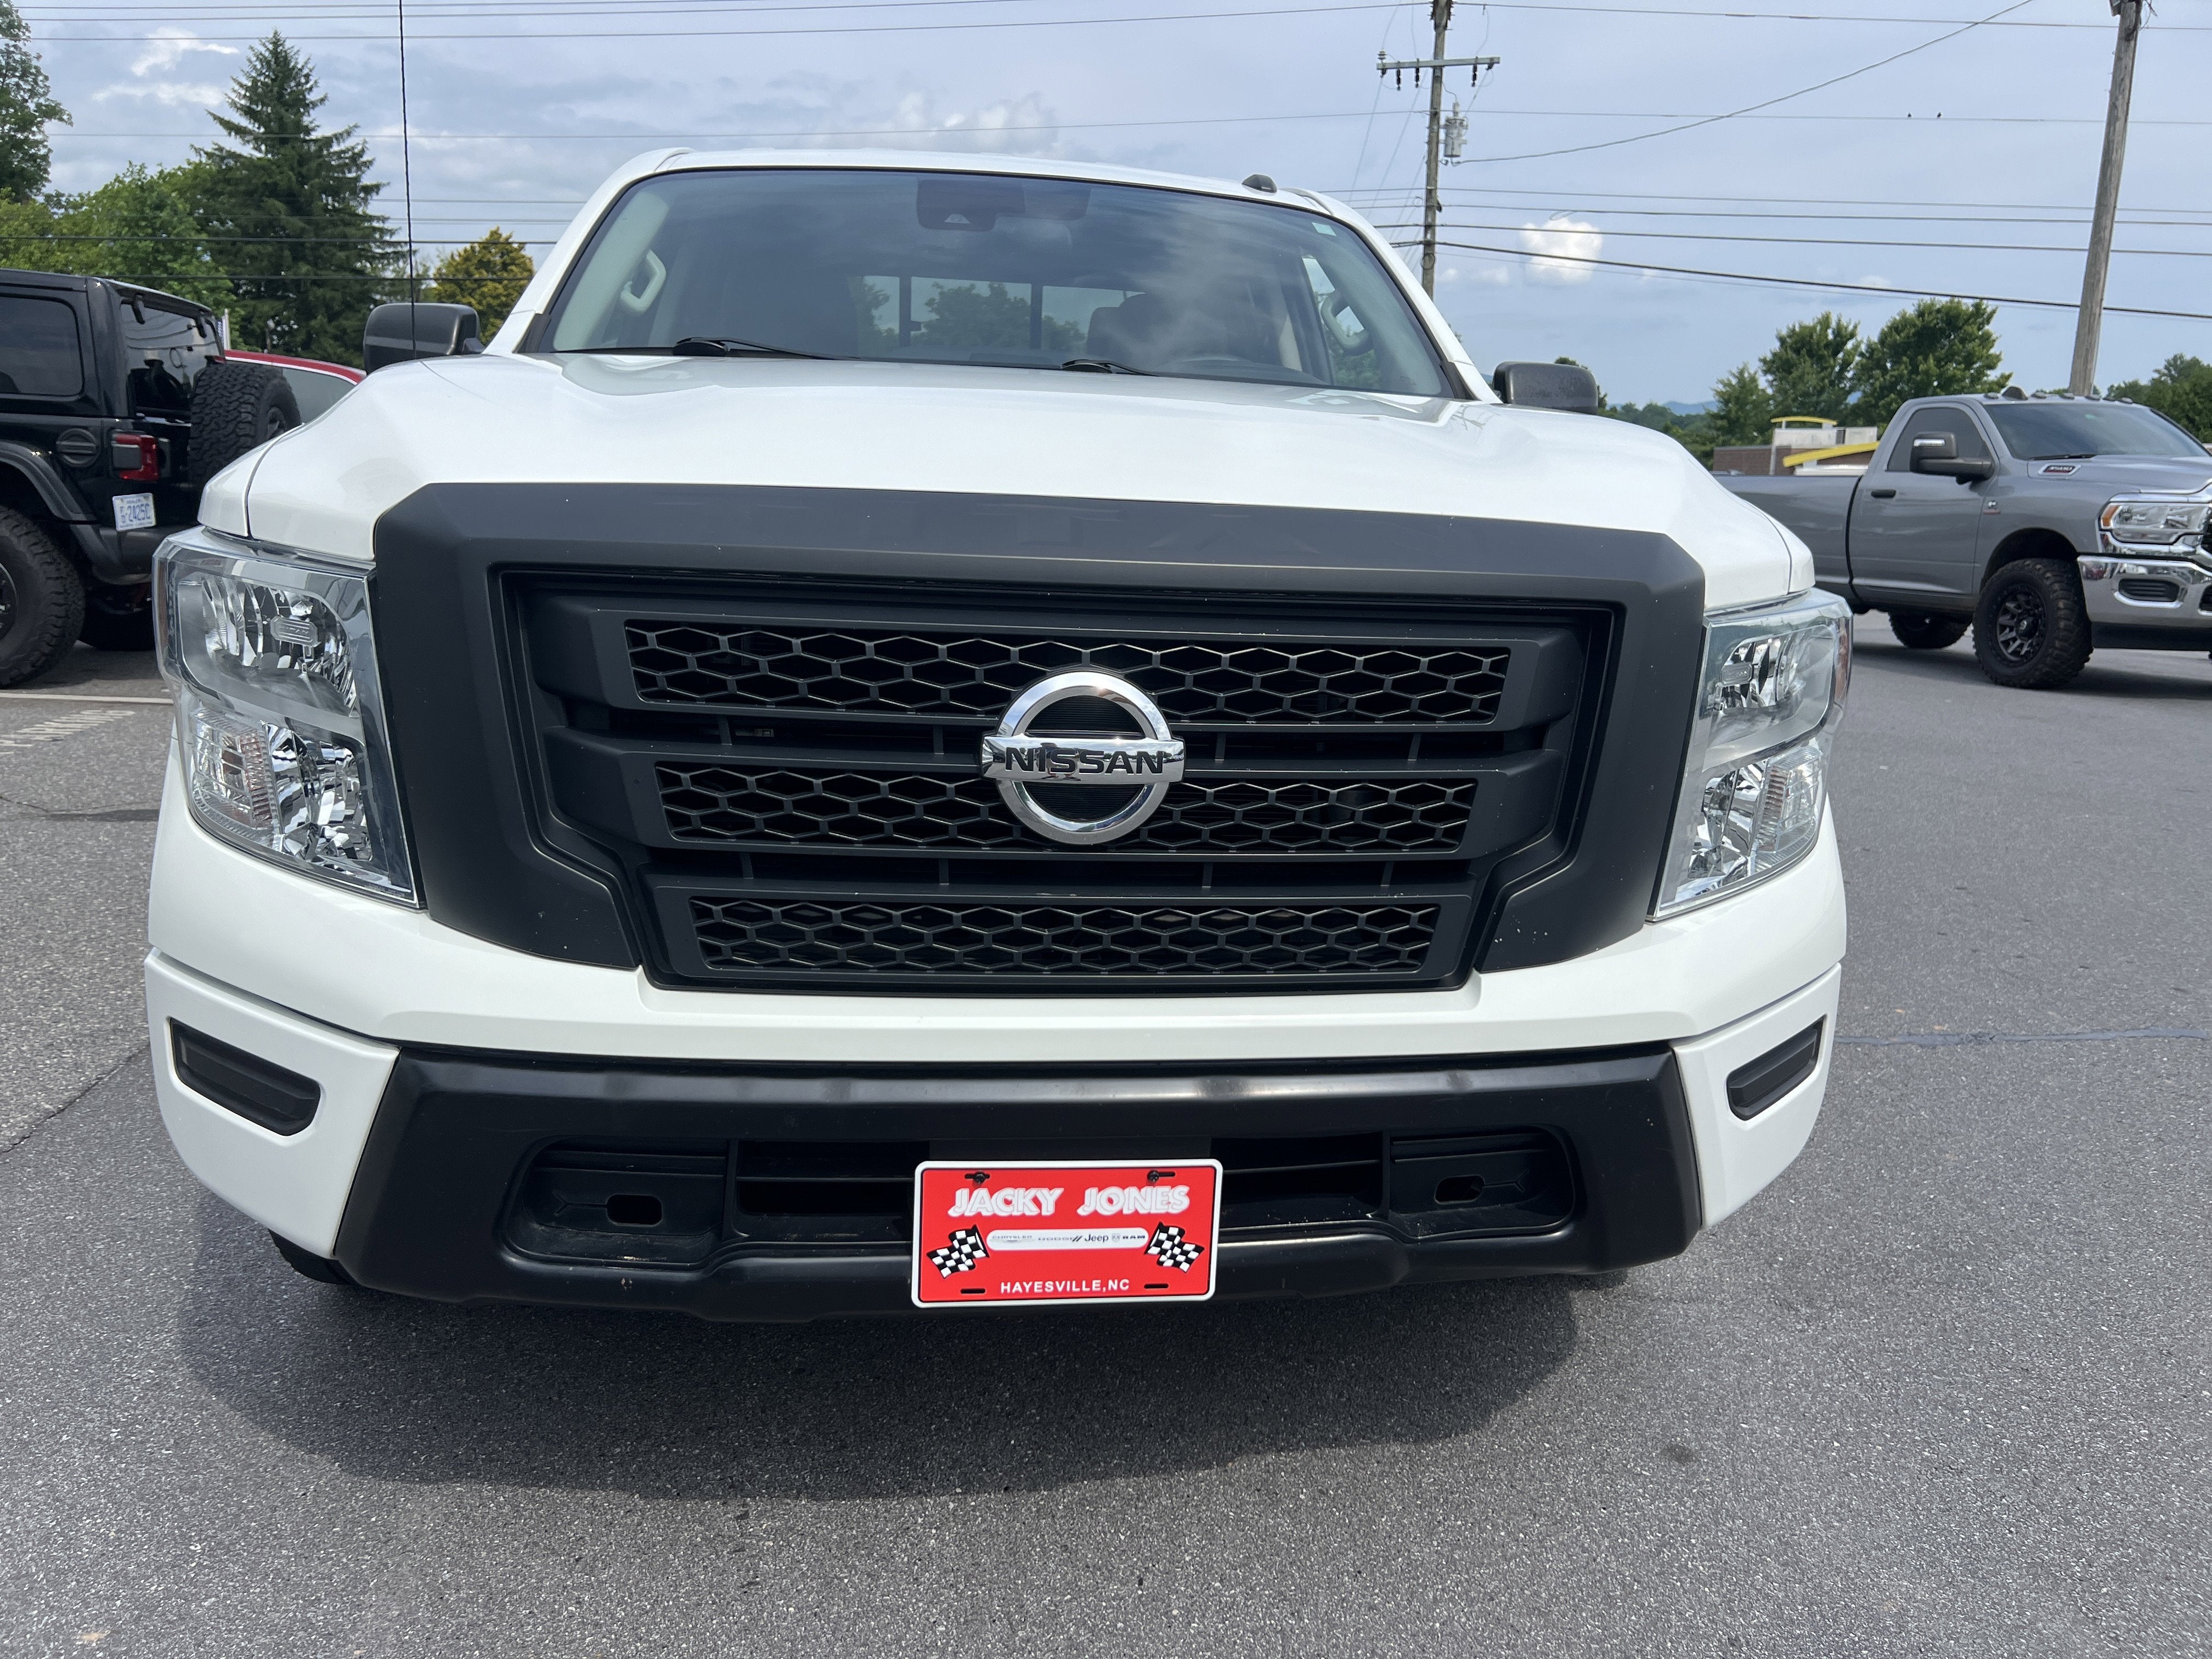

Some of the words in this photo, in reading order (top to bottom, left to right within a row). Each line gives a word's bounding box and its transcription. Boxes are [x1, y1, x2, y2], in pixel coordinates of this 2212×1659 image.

[1005, 747, 1163, 775] NISSAN
[947, 1187, 1064, 1217] JACKY
[1076, 1184, 1190, 1216] JONES
[1084, 1233, 1109, 1243] Jeep
